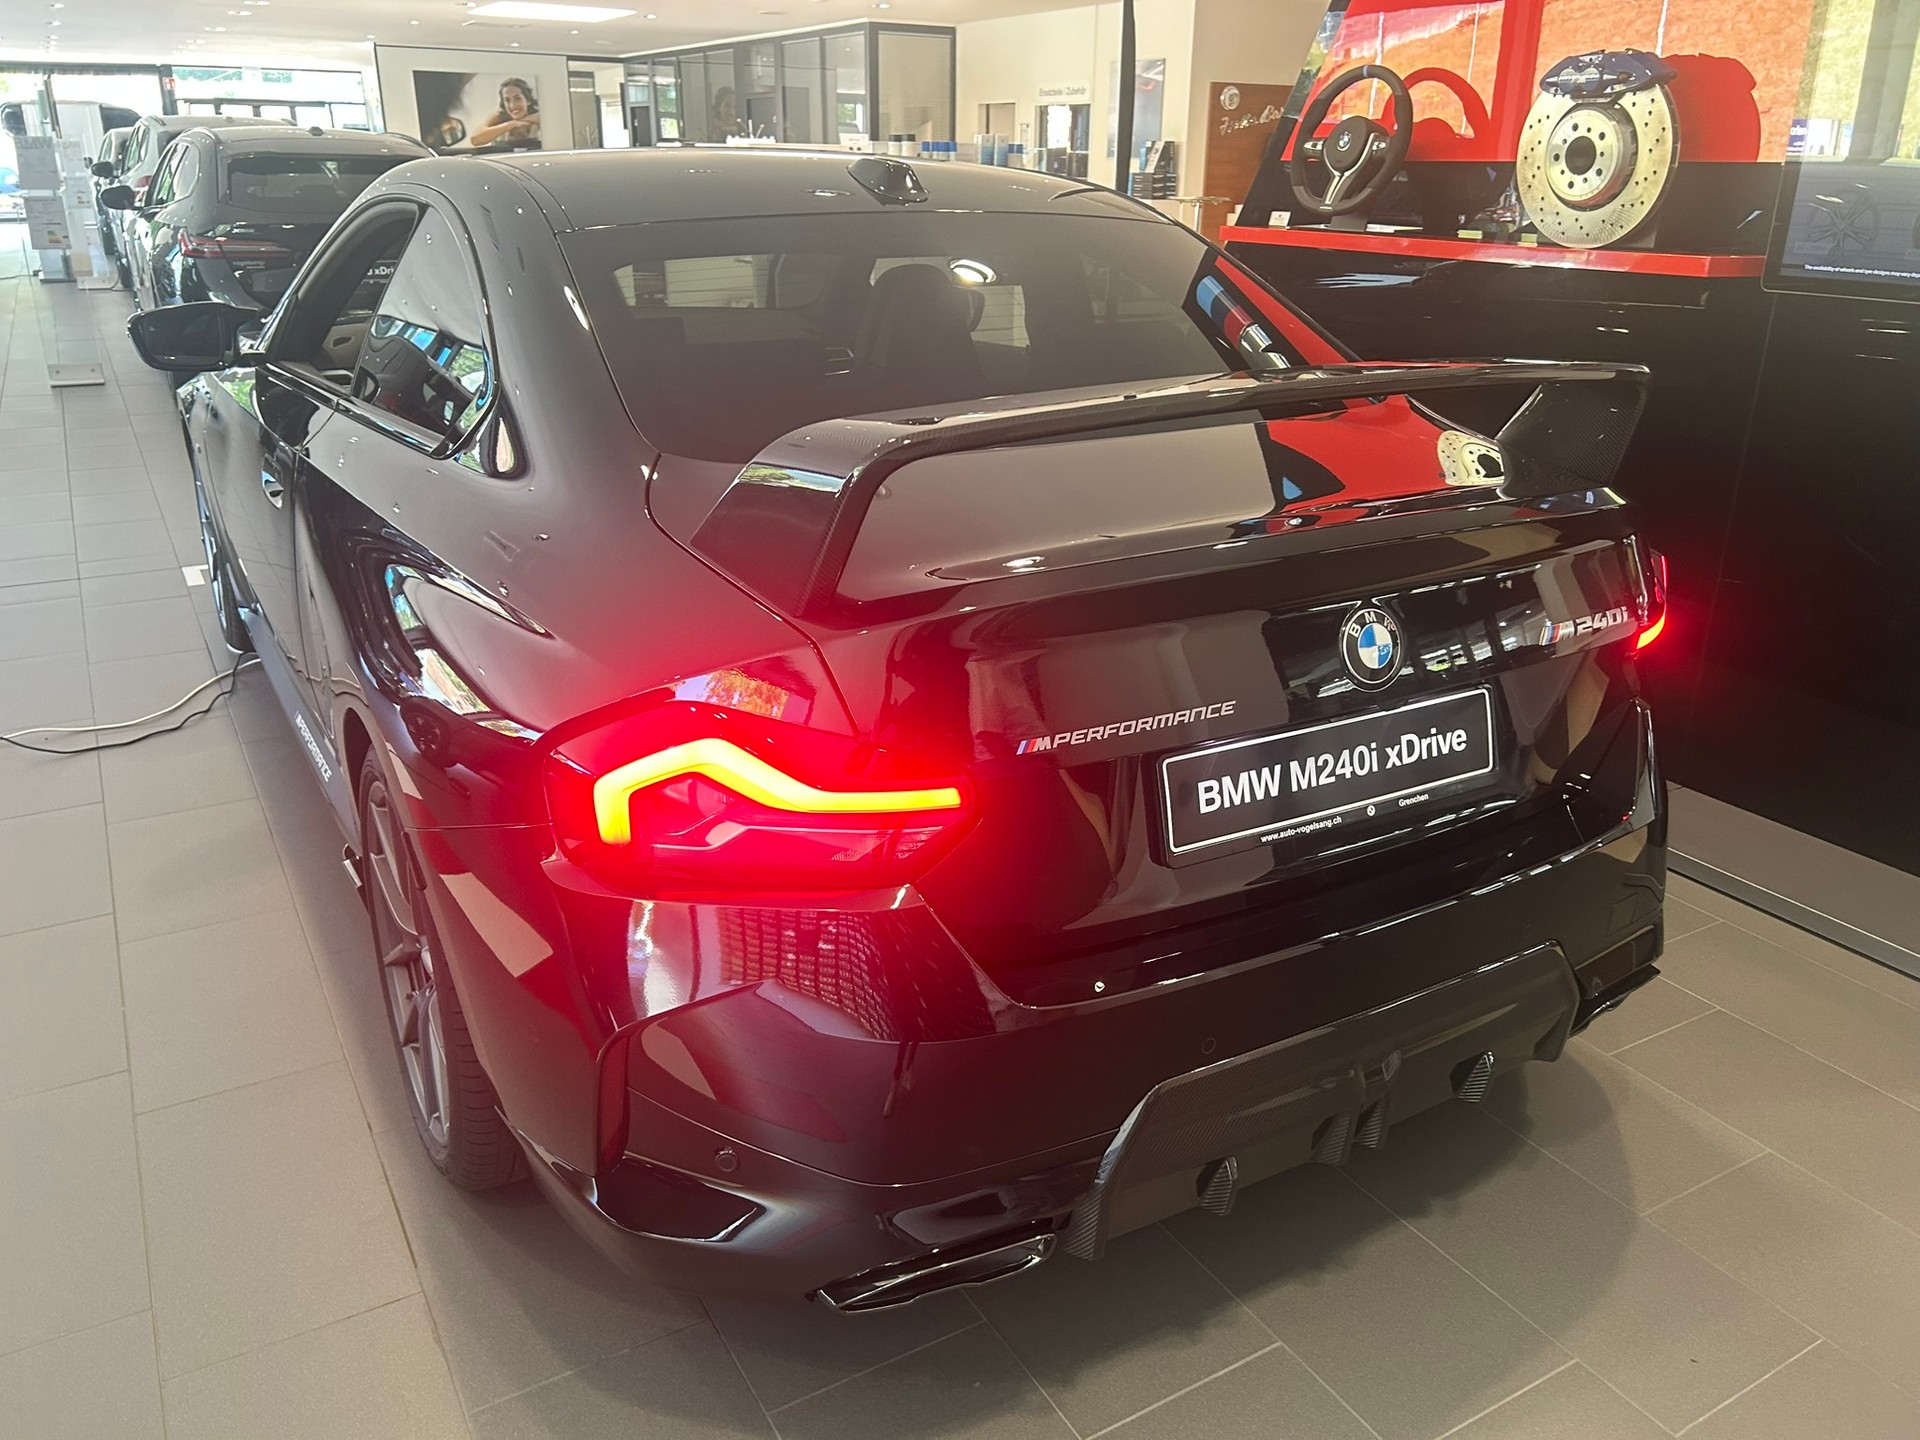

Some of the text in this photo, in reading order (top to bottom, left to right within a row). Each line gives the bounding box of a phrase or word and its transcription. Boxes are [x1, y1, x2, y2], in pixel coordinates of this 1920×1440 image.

[1348, 610, 1397, 638] BMW
[1053, 700, 1237, 750] PERFORMANCE
[1197, 727, 1468, 814] BMW M240i xDrive
[1260, 792, 1430, 843] www.auto-vogelsang.ch Grenchen
